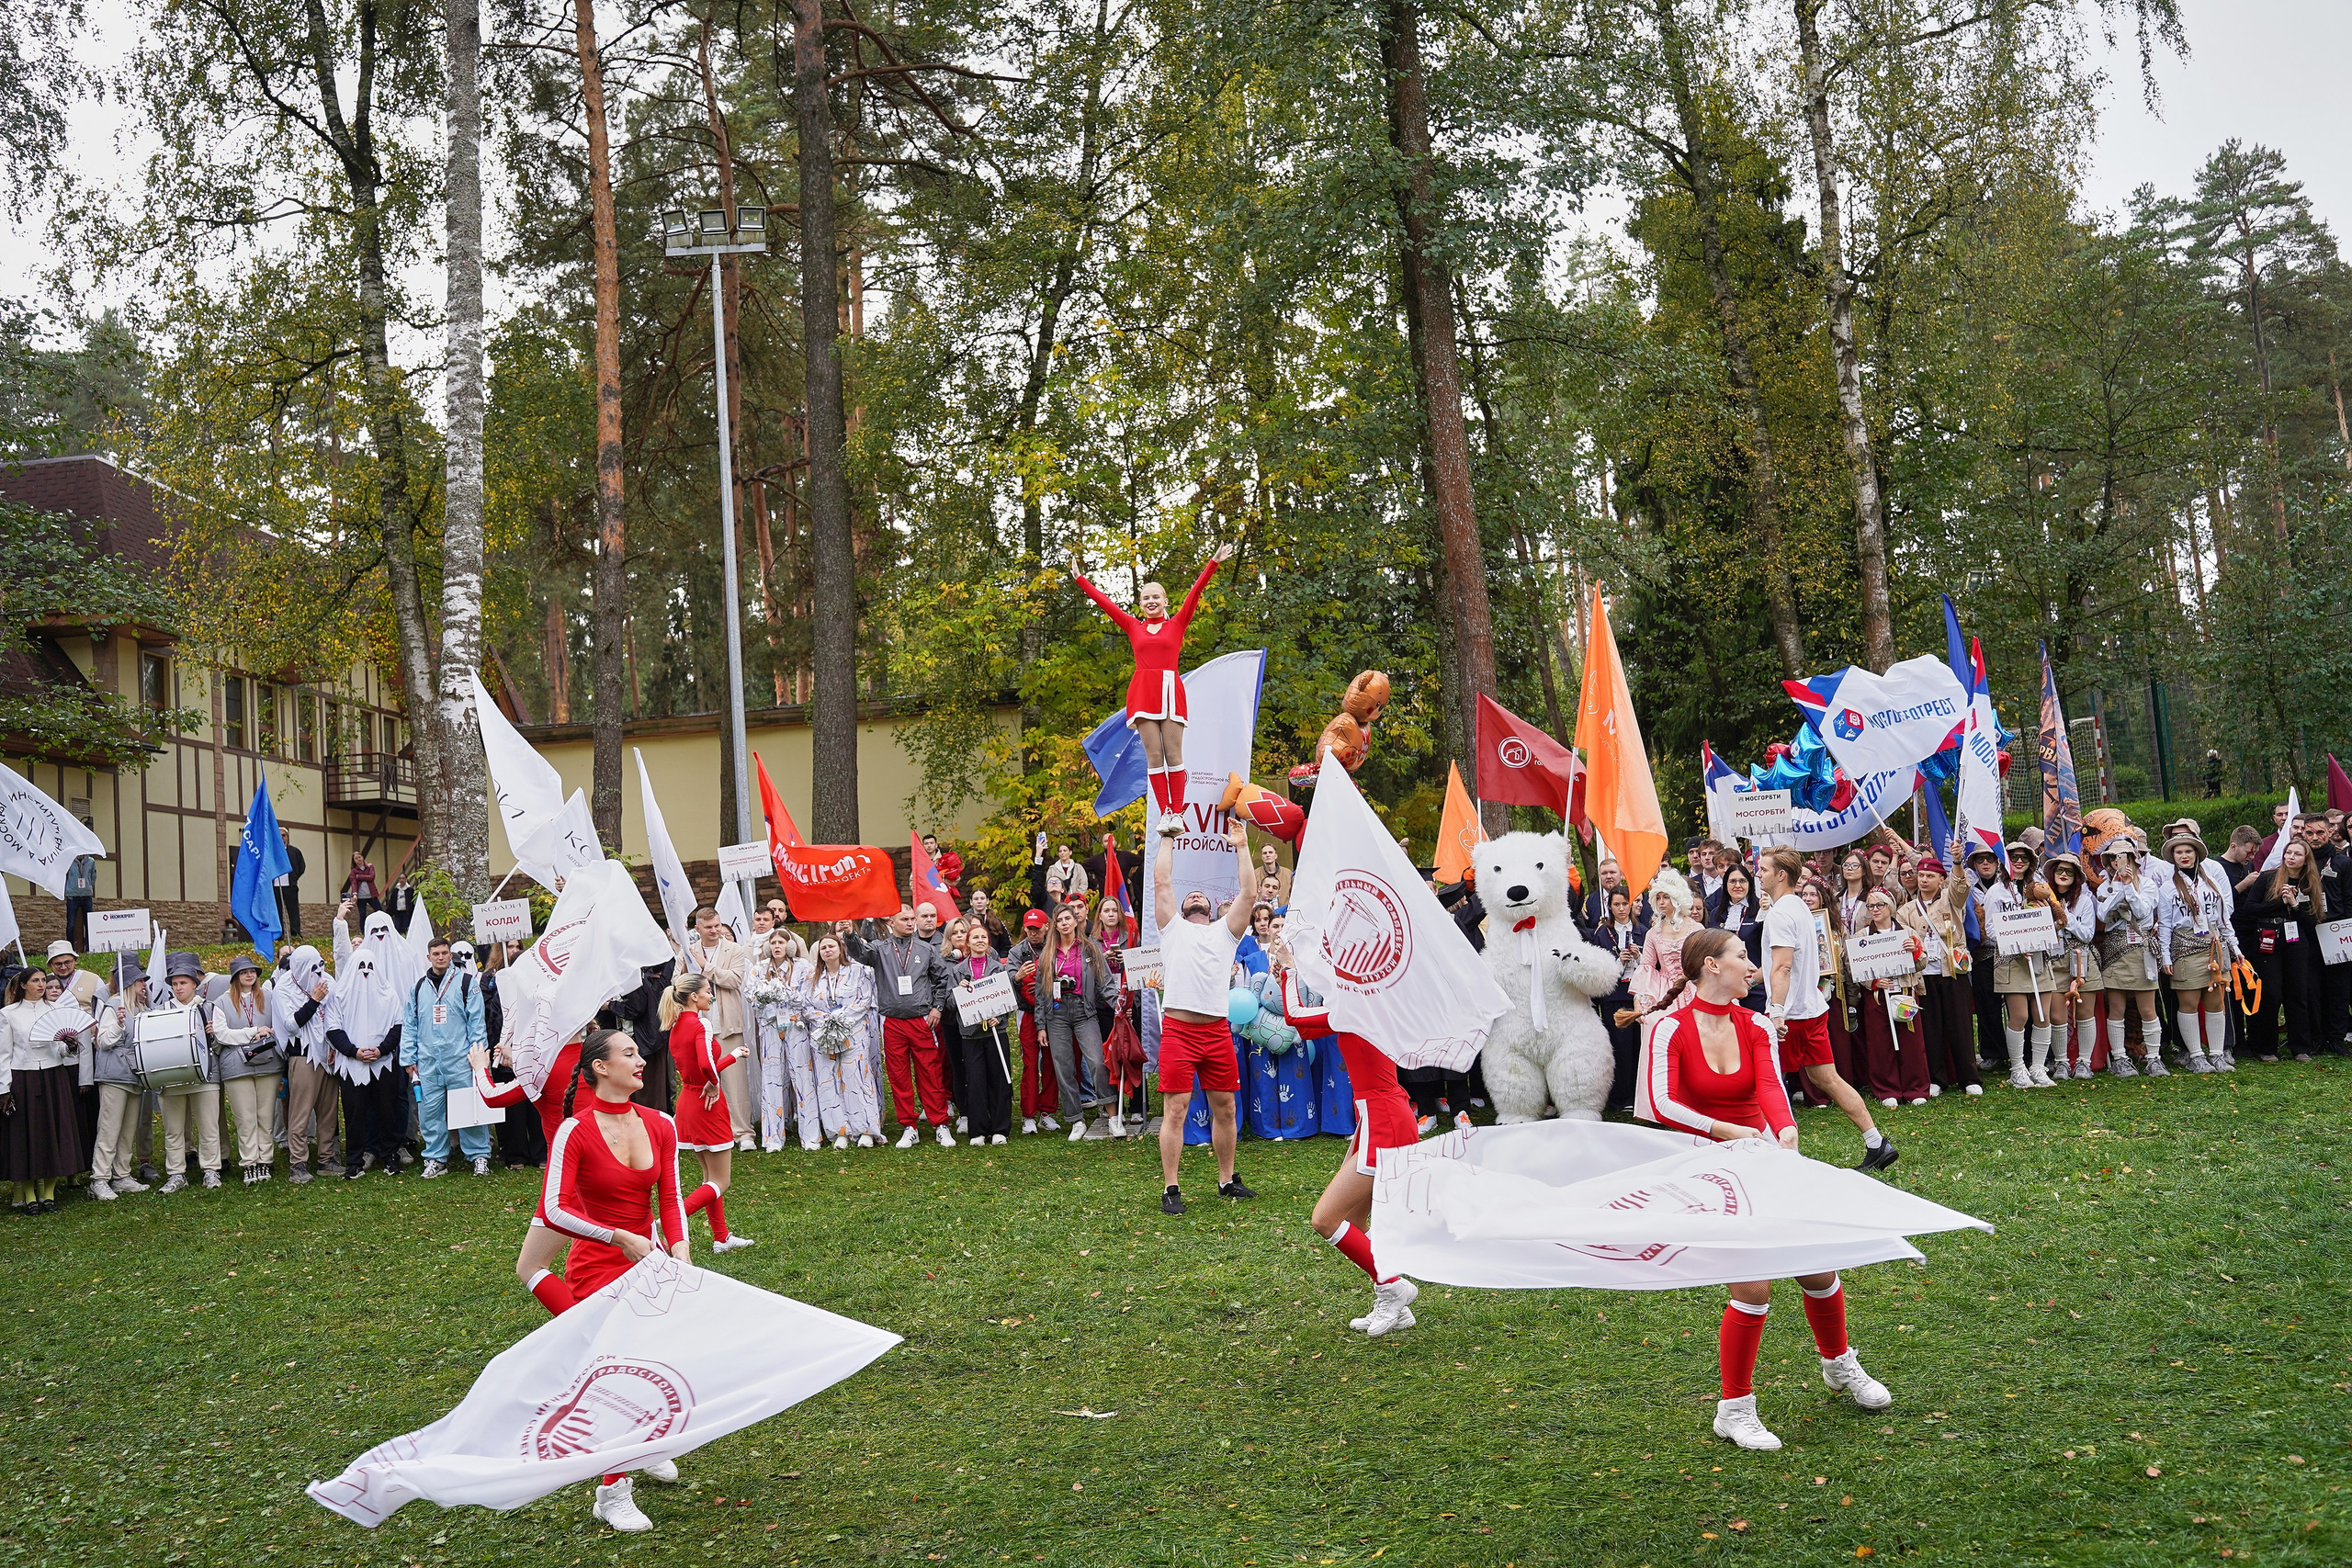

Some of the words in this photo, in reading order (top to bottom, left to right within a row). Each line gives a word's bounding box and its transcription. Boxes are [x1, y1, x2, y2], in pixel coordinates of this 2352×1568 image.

[1745, 794, 1781, 802] МОСГОРБТИ
[1736, 808, 1786, 818] МОСГОРБТИ
[485, 915, 521, 927] КОЛДИ
[1998, 924, 2053, 937] МОСИНЖПРОЕКТ
[1852, 949, 1909, 963] МОСГОРГЕОТРЕСТ
[960, 990, 1001, 1010] МИП-СТРОЙ
[1001, 987, 1012, 996] №1
